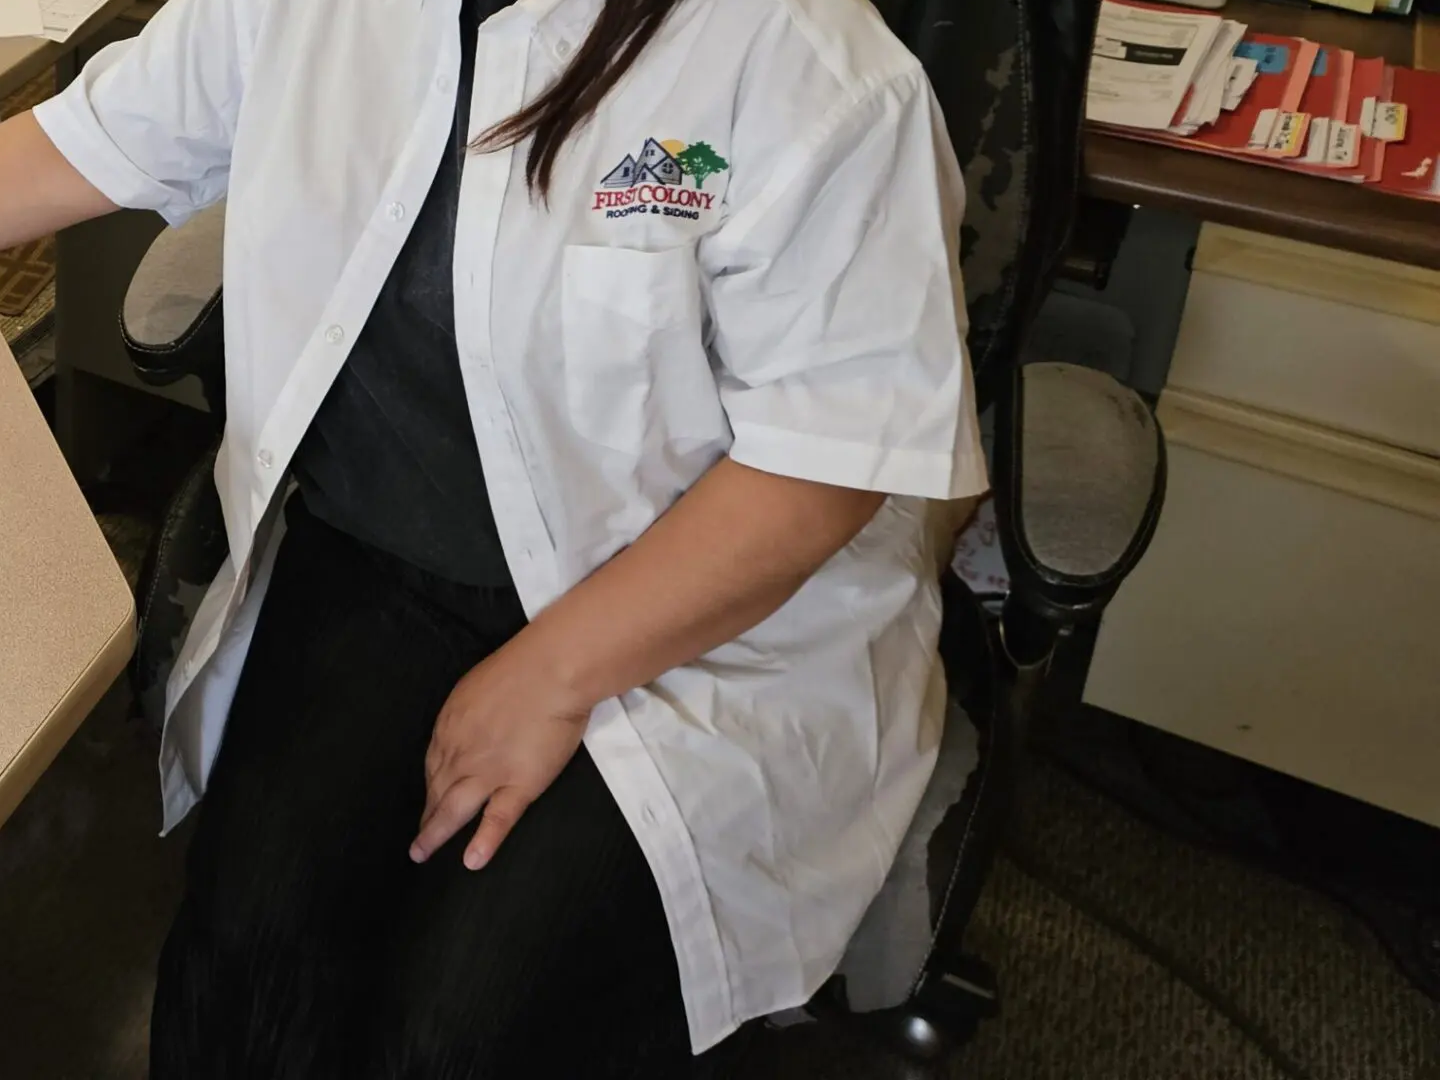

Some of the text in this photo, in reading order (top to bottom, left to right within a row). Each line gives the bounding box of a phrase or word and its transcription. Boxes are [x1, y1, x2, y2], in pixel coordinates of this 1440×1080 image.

[639, 184, 715, 210] COLONY
[606, 204, 700, 220] ROOING & SIDING
